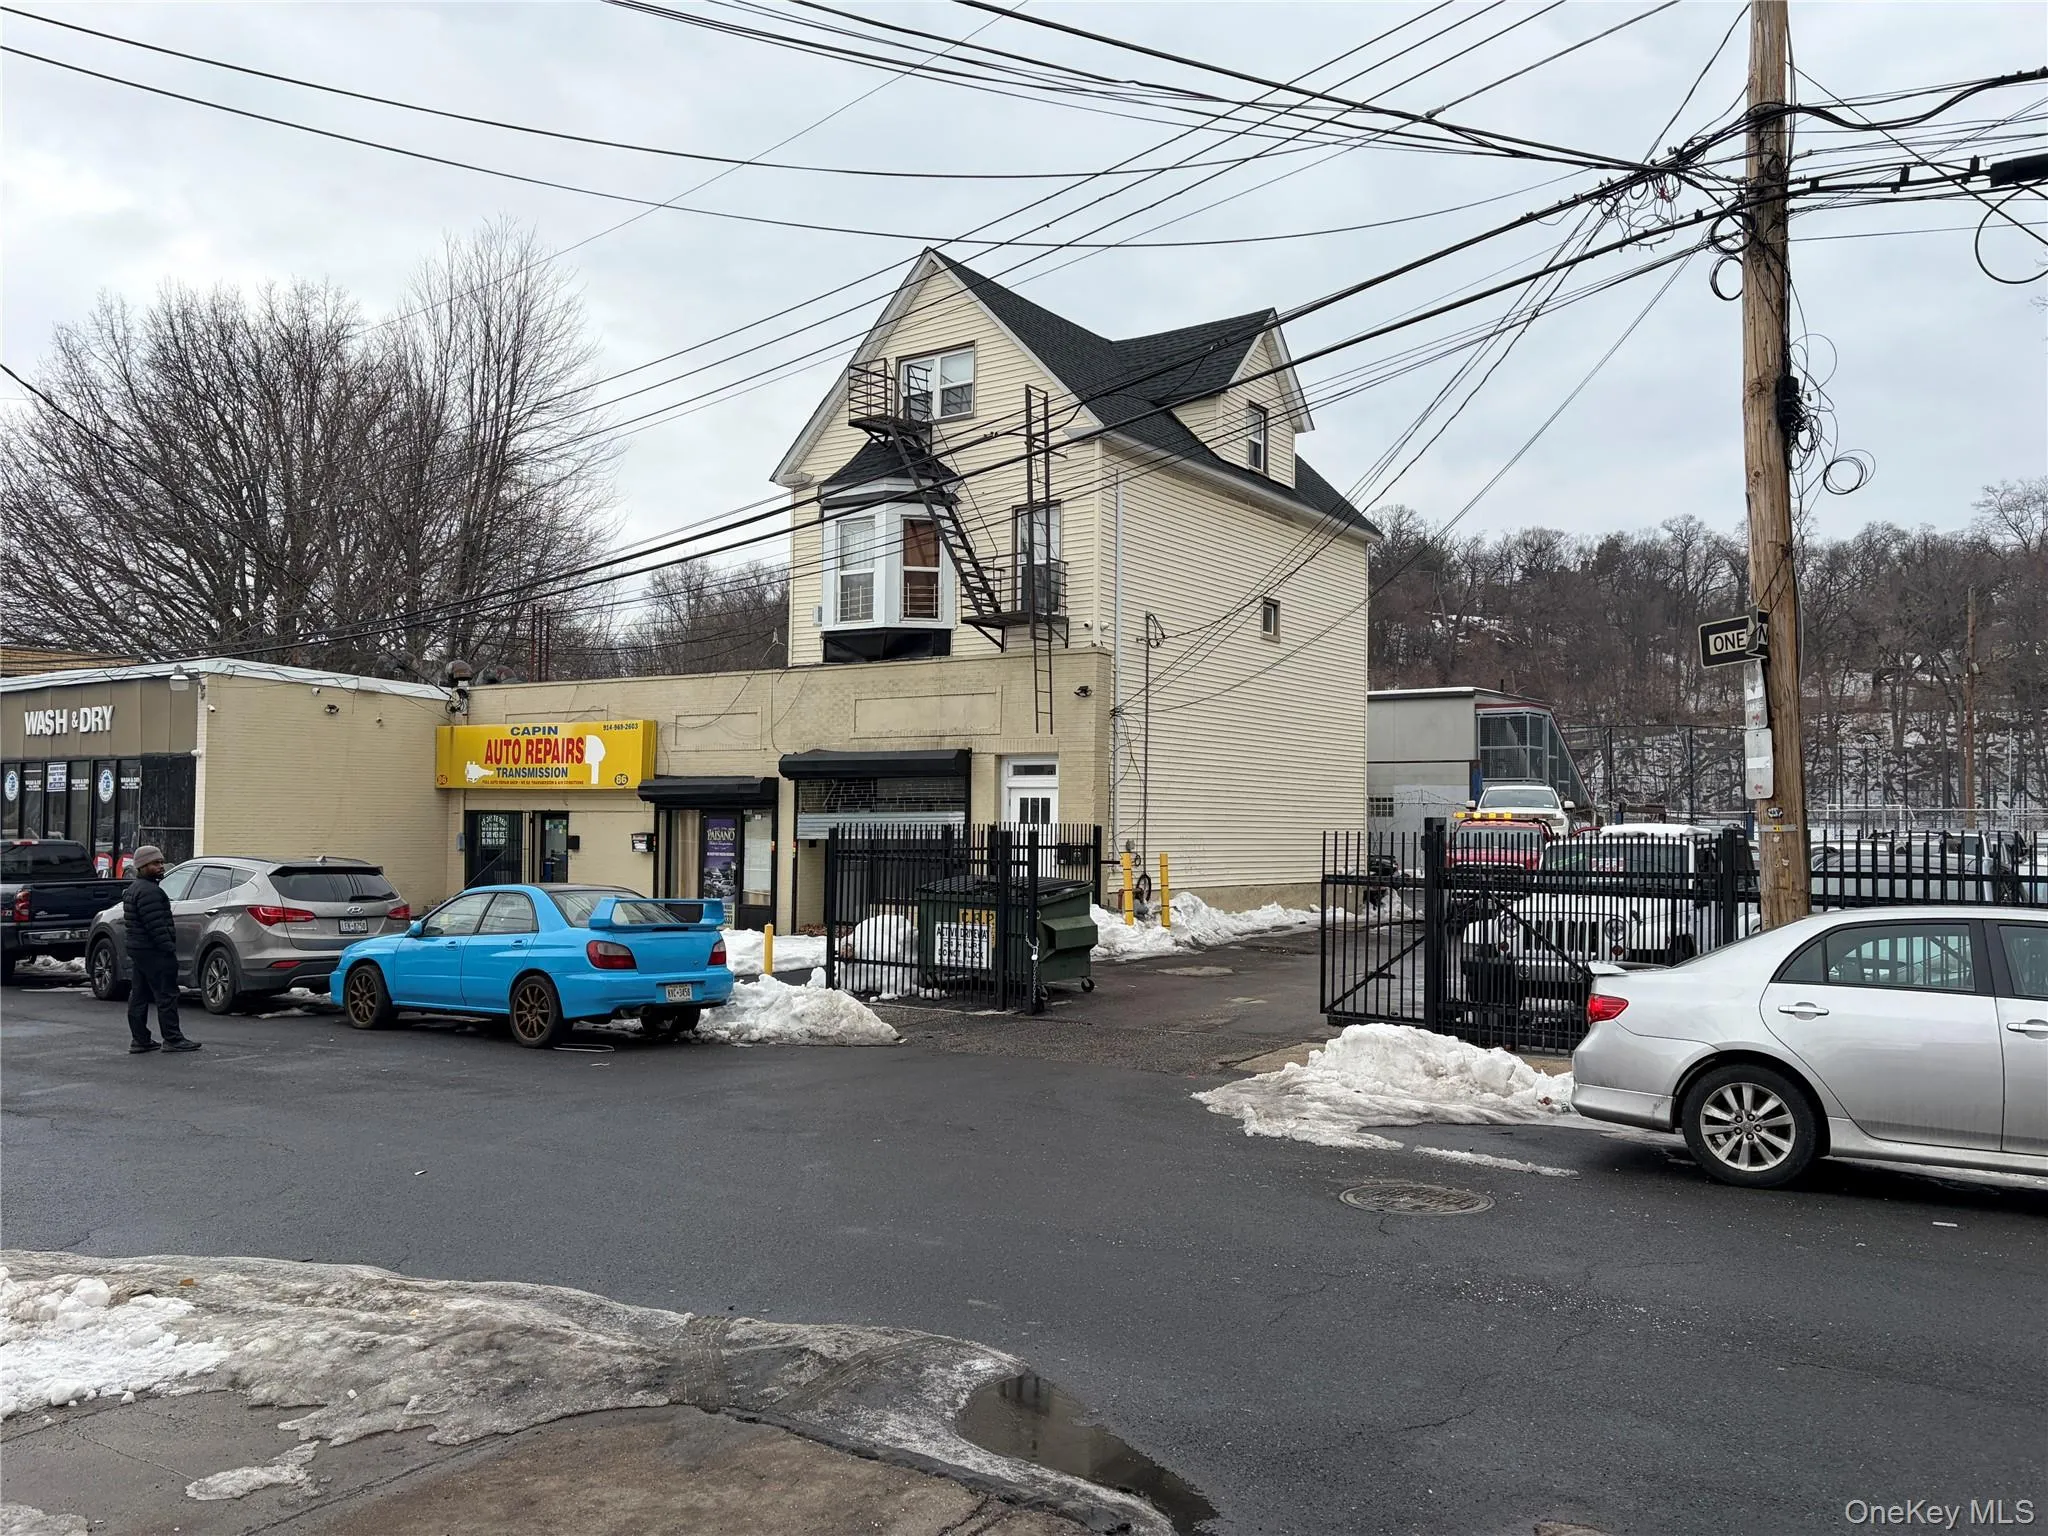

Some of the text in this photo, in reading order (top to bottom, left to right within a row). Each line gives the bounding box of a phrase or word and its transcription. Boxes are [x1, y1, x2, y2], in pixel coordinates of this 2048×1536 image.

[1713, 630, 1747, 653] ONE
[24, 705, 114, 736] WASH & DRY
[510, 726, 559, 736] CAPIN
[484, 737, 585, 765] AUTO REPAIRS
[496, 767, 568, 778] TRANSMISSION
[615, 775, 627, 784] 86
[707, 829, 736, 841] PAISANO
[936, 926, 958, 937] ATV
[960, 927, 990, 940] DRIEA
[957, 941, 981, 949] HUR
